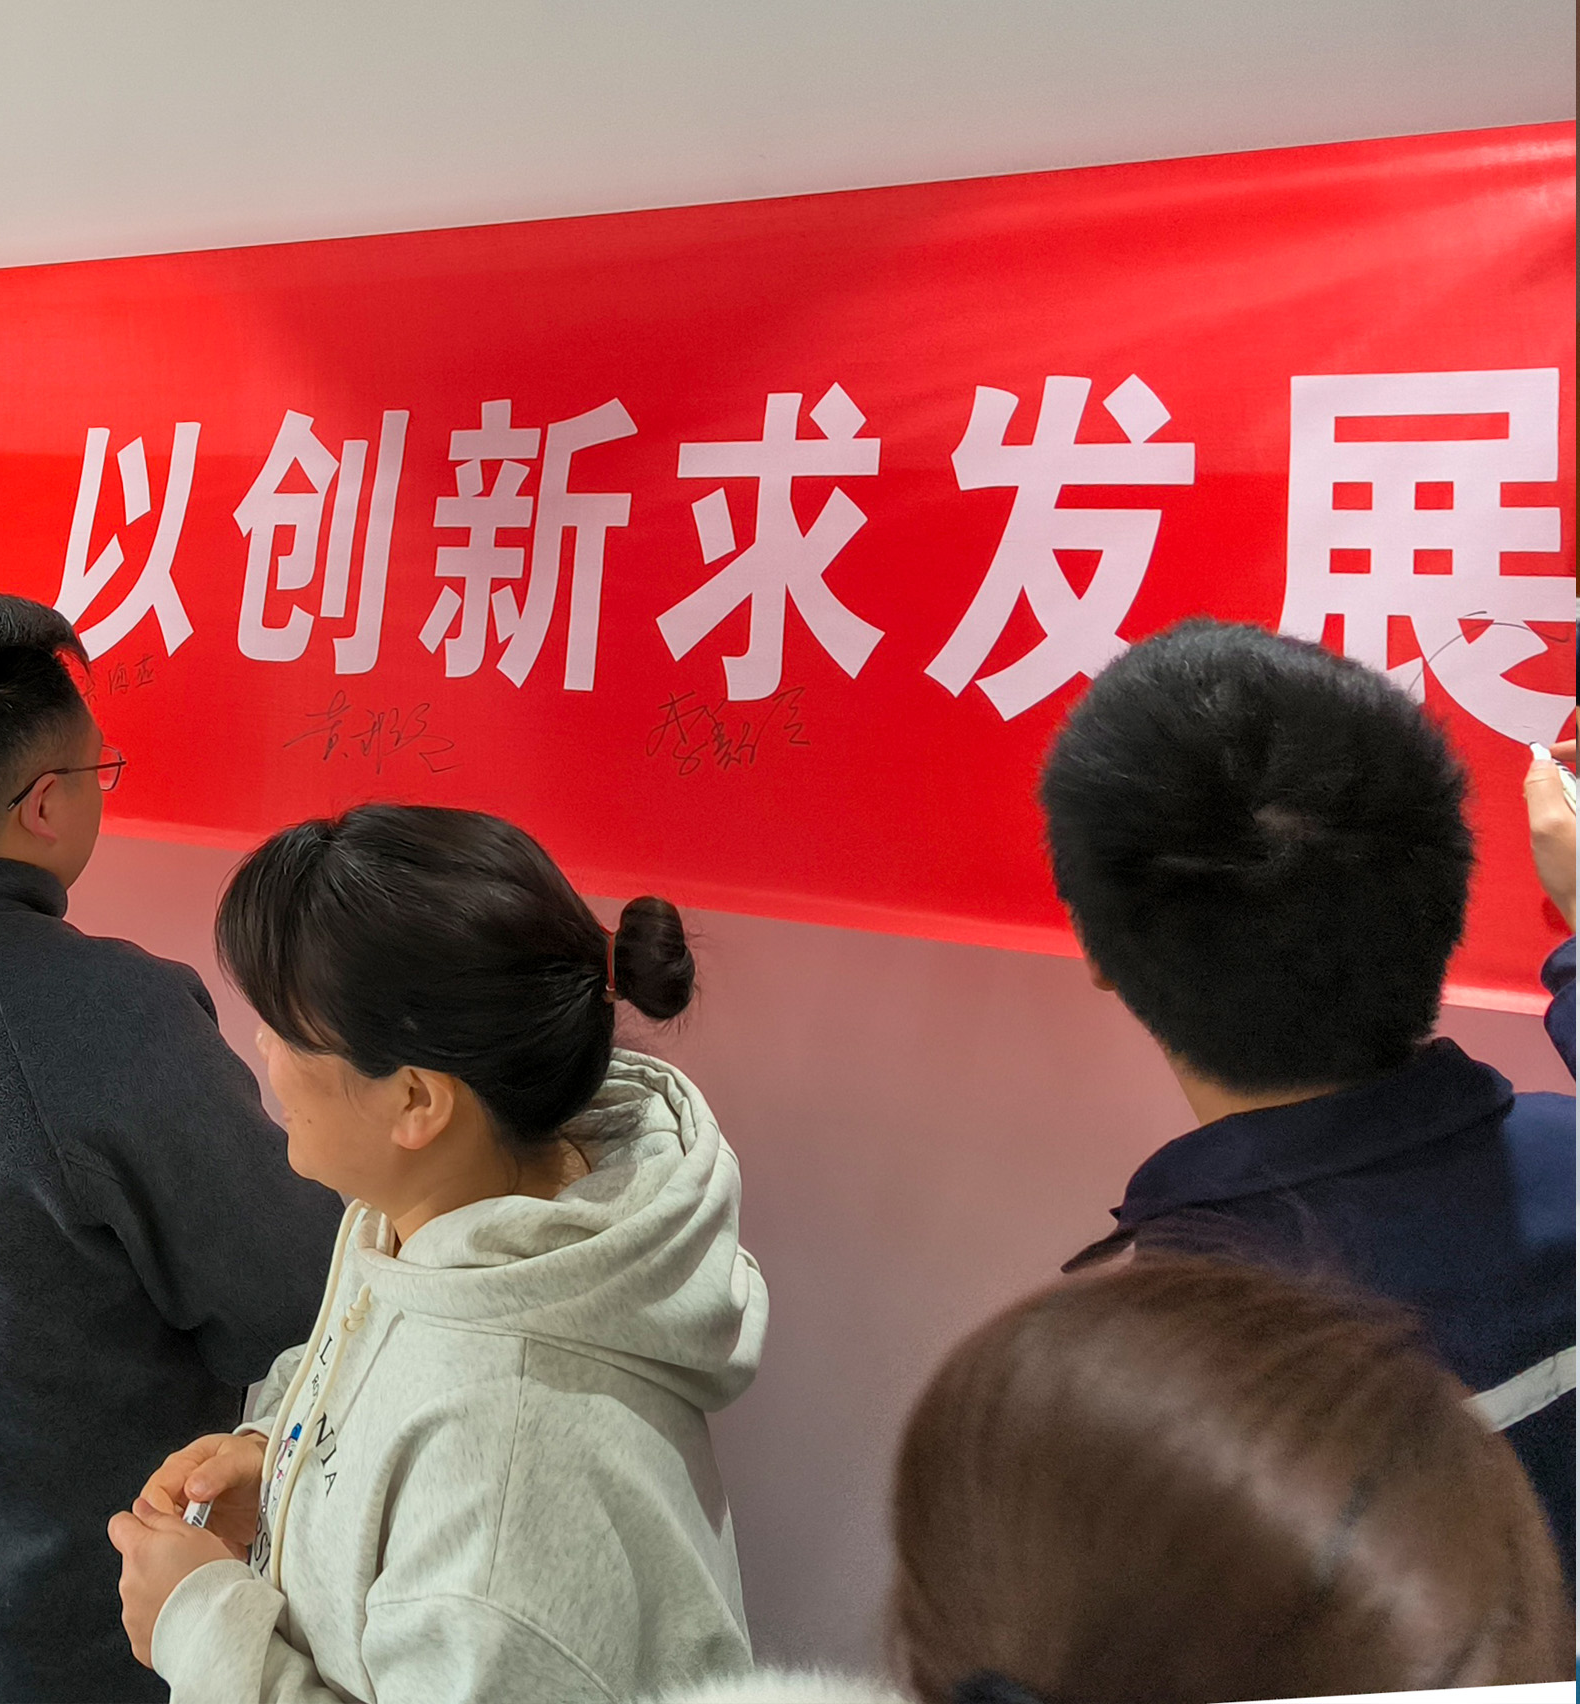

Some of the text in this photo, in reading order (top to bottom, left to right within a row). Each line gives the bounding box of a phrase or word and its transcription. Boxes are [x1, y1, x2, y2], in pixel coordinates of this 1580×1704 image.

[55, 367, 1577, 746] 以创新求发展
